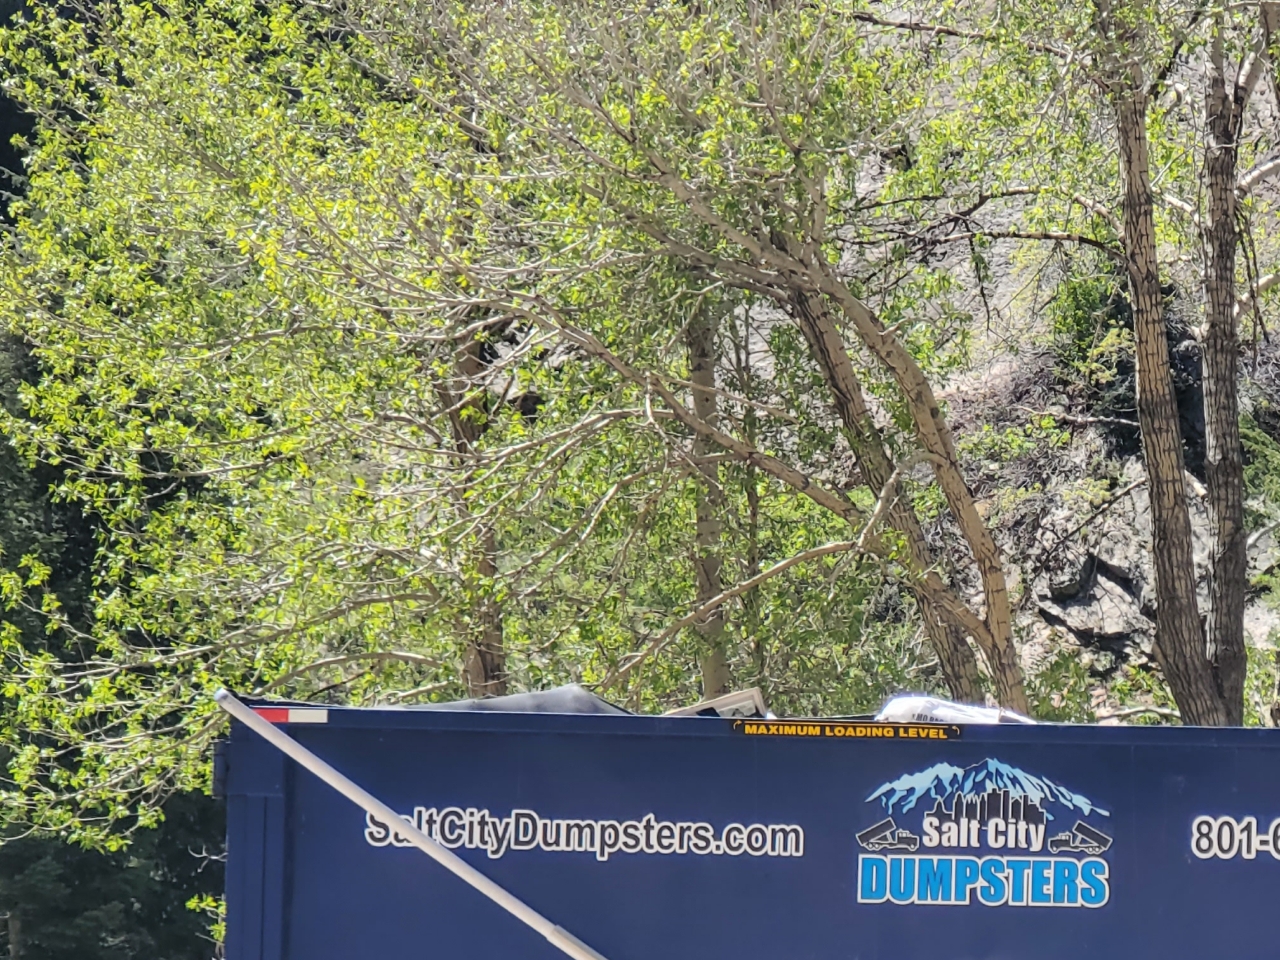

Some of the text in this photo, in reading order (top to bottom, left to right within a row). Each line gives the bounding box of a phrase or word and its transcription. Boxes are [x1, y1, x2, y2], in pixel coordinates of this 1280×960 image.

[744, 724, 948, 739] MAXIMUM LOADING LEVEL
[922, 816, 1047, 852] Salt City
[857, 853, 1110, 908] DUMPSTERS
